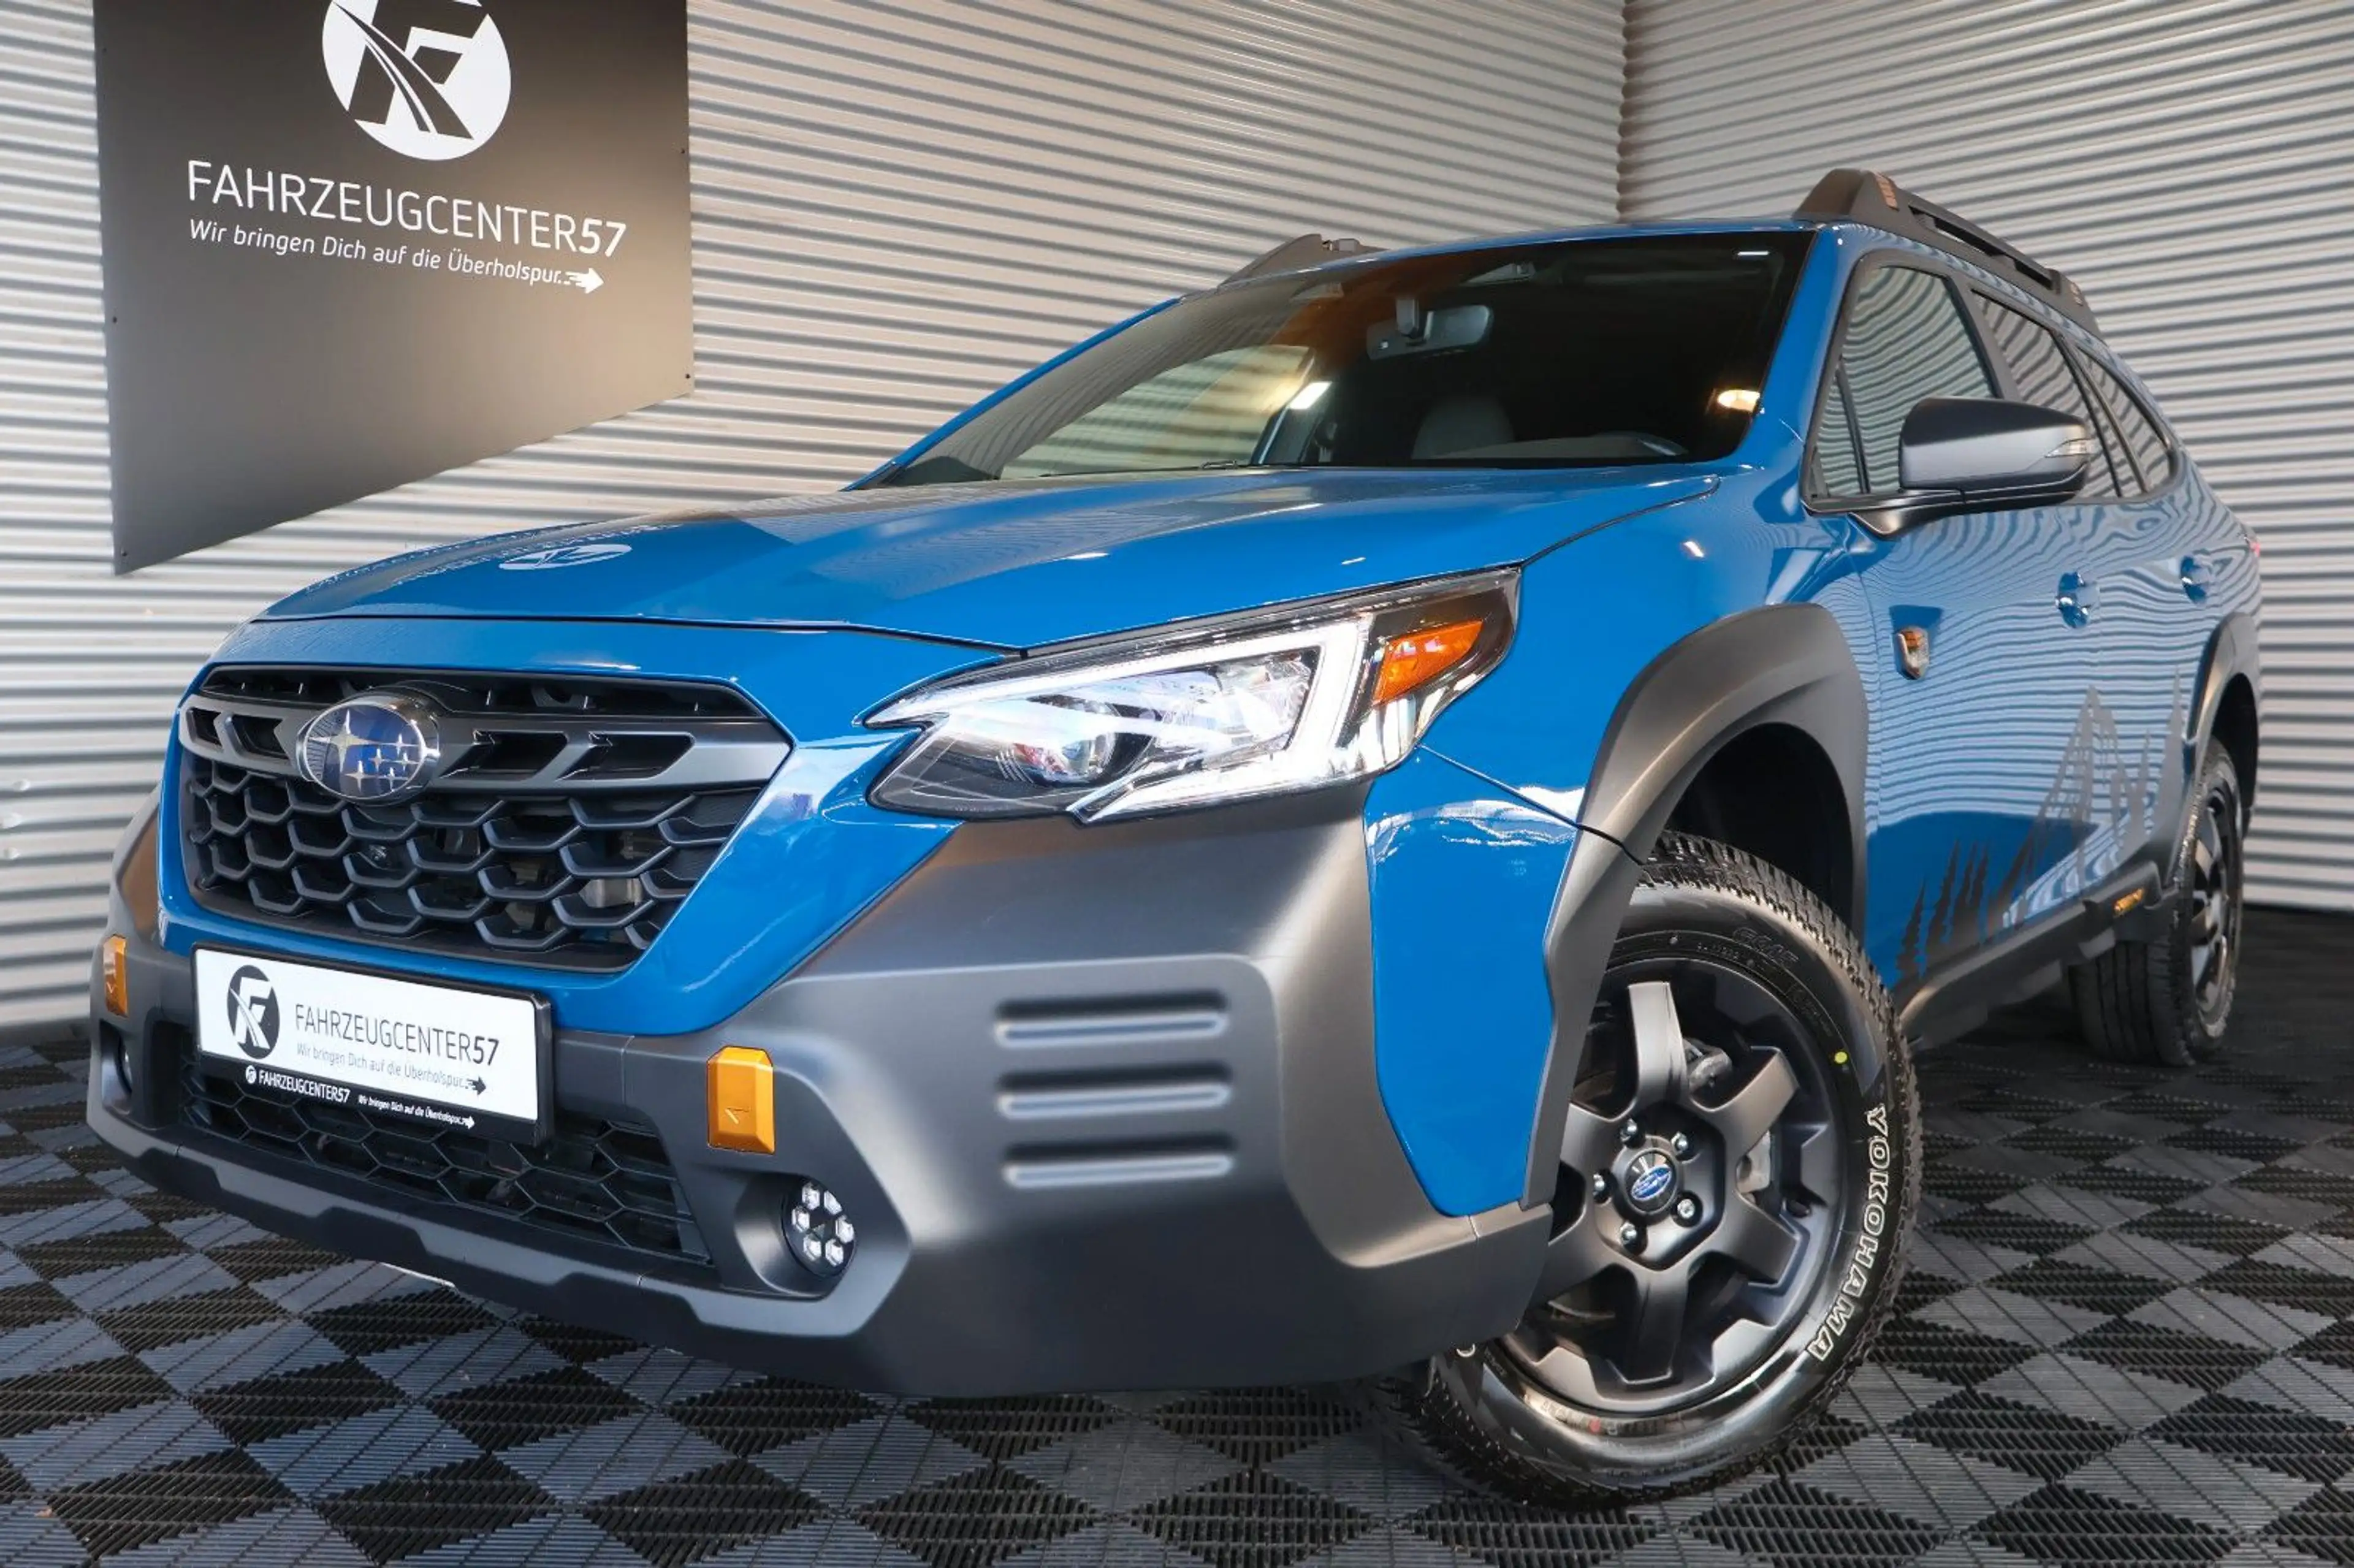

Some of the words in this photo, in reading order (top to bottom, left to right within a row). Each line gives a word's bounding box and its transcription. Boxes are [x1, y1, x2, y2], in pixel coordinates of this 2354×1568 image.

[187, 159, 627, 257] FAHRZEUGCENTER57
[189, 218, 227, 243] Wir
[233, 224, 315, 256] bringen
[322, 235, 367, 260] Dich
[372, 245, 408, 264] auf
[411, 248, 442, 269] die
[295, 1003, 500, 1067] FAHRZEUGCENTER57
[297, 1042, 311, 1056] Wir
[312, 1045, 345, 1067] bringen
[348, 1052, 368, 1069] Dich
[369, 1059, 385, 1073] auf
[386, 1062, 401, 1076] die
[258, 1068, 351, 1103] FAHRZEUGCENTER57
[1808, 1102, 1891, 1362] YOKOHAMA
